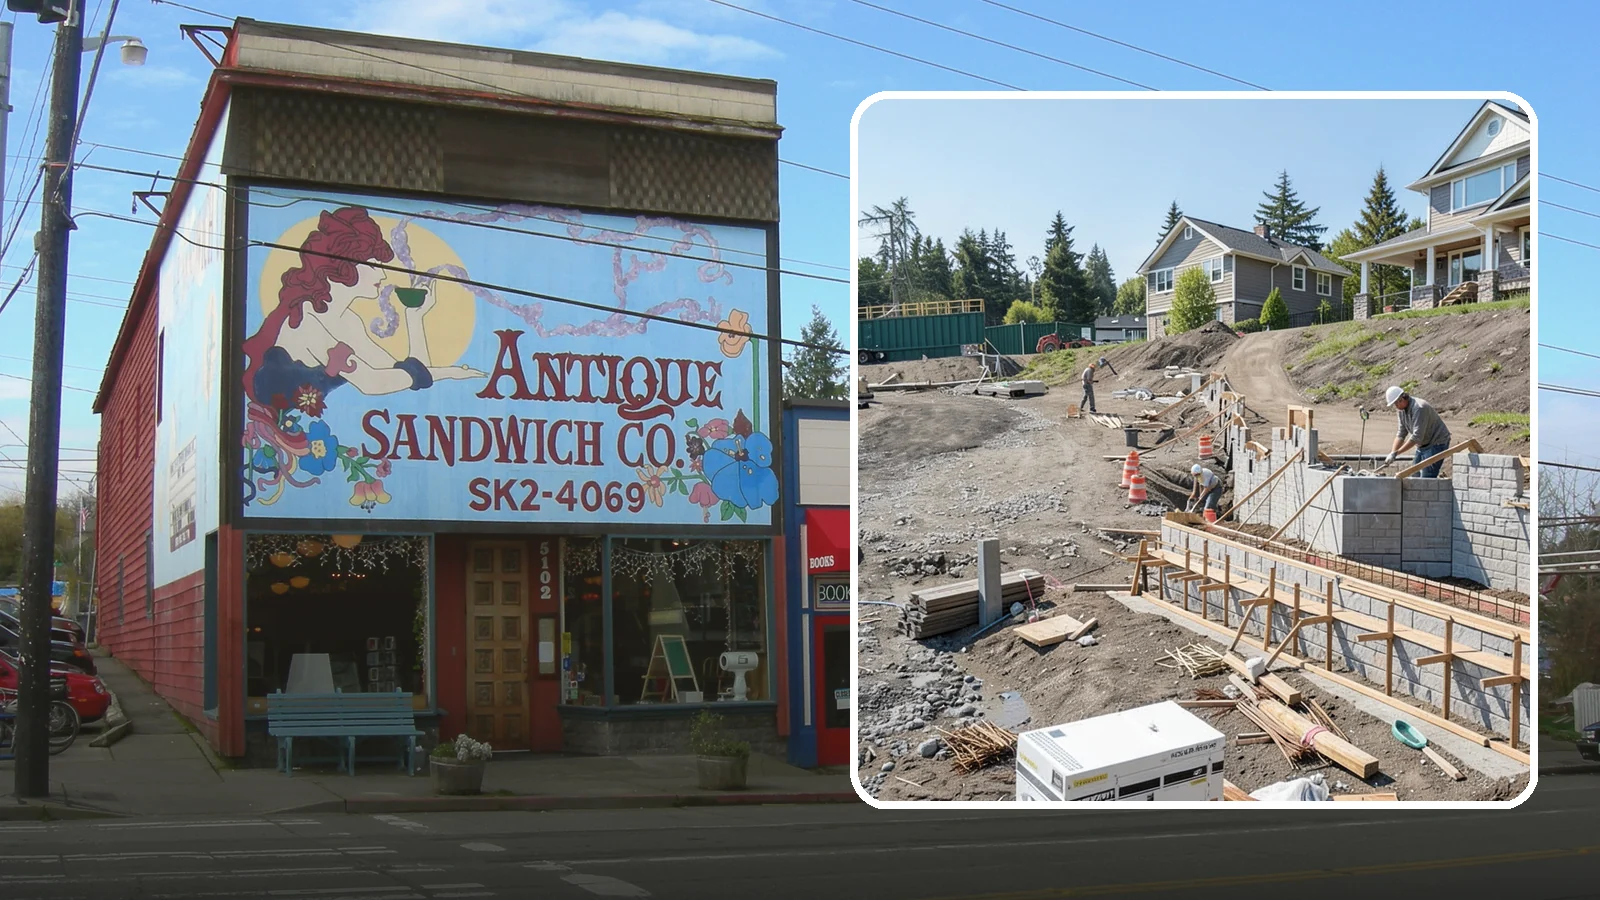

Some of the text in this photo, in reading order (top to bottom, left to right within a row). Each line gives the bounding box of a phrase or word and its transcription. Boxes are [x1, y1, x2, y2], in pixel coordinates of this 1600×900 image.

[476, 329, 724, 421] ANTIQUE
[361, 408, 684, 468] SANDWICH CO.
[468, 477, 646, 512] SK2-4069
[539, 542, 551, 600] 5102
[809, 555, 835, 569] BOOKS
